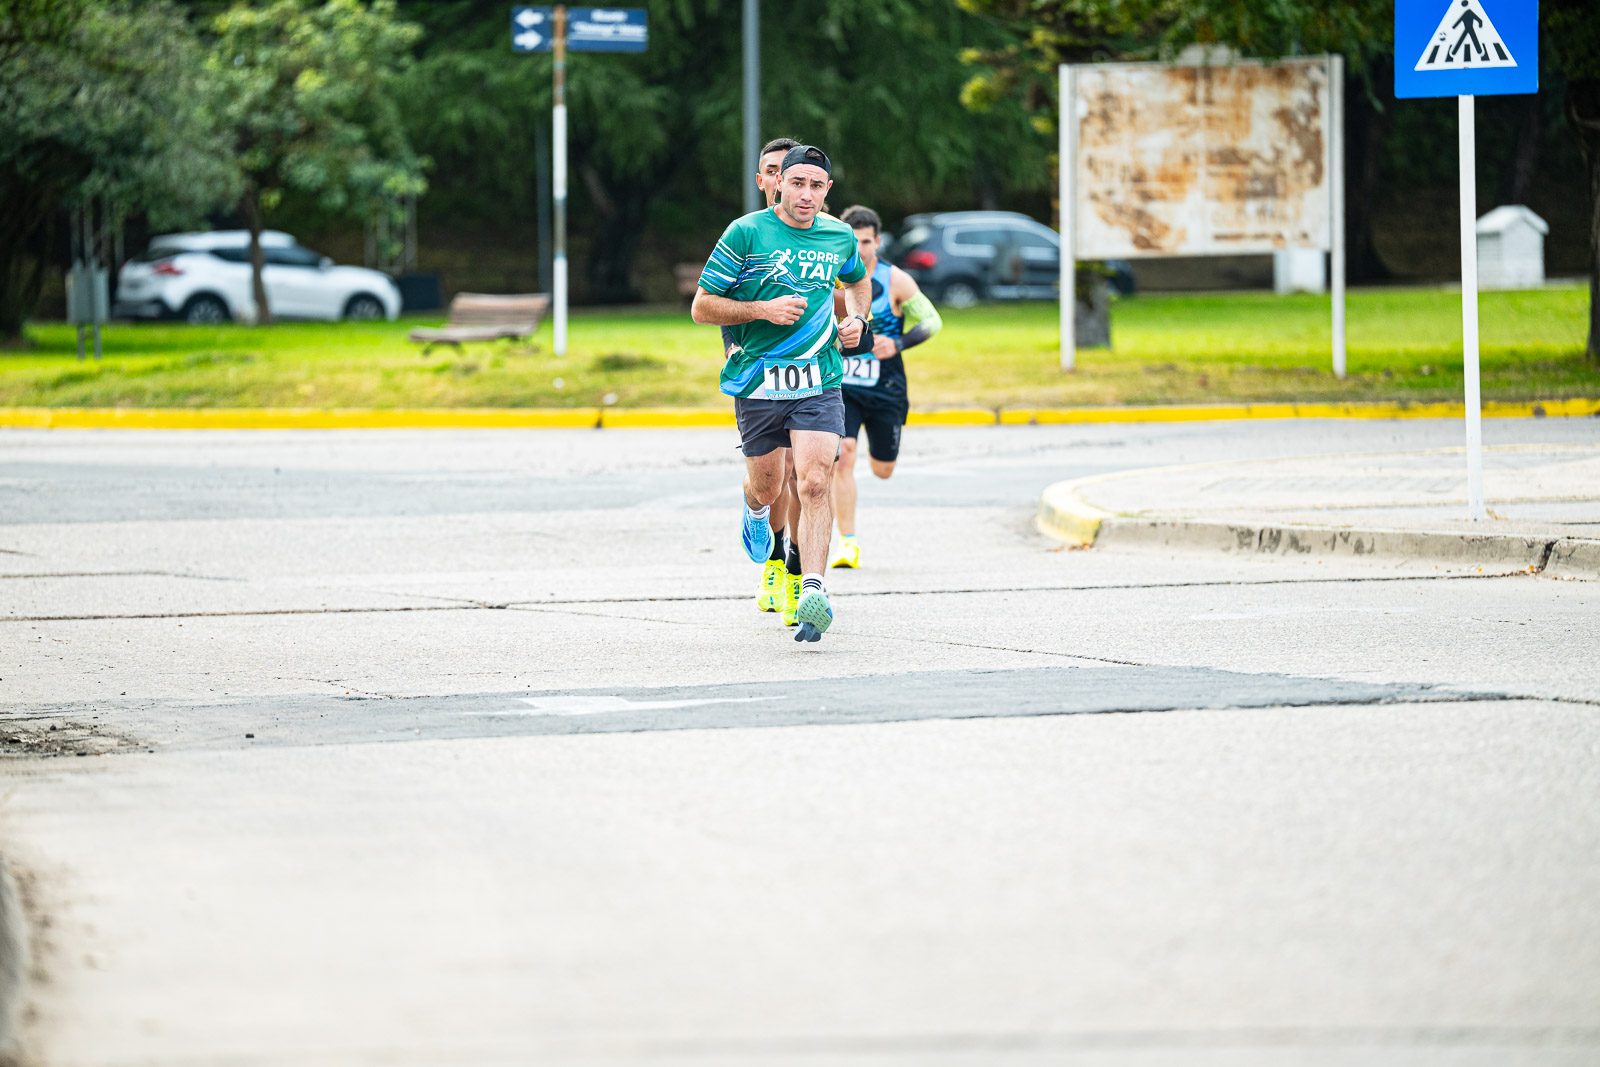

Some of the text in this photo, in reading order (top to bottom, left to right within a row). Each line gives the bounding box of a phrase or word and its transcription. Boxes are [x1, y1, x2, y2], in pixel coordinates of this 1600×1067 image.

[798, 250, 839, 264] CORRE
[799, 262, 833, 281] TAI
[769, 362, 814, 392] 101
